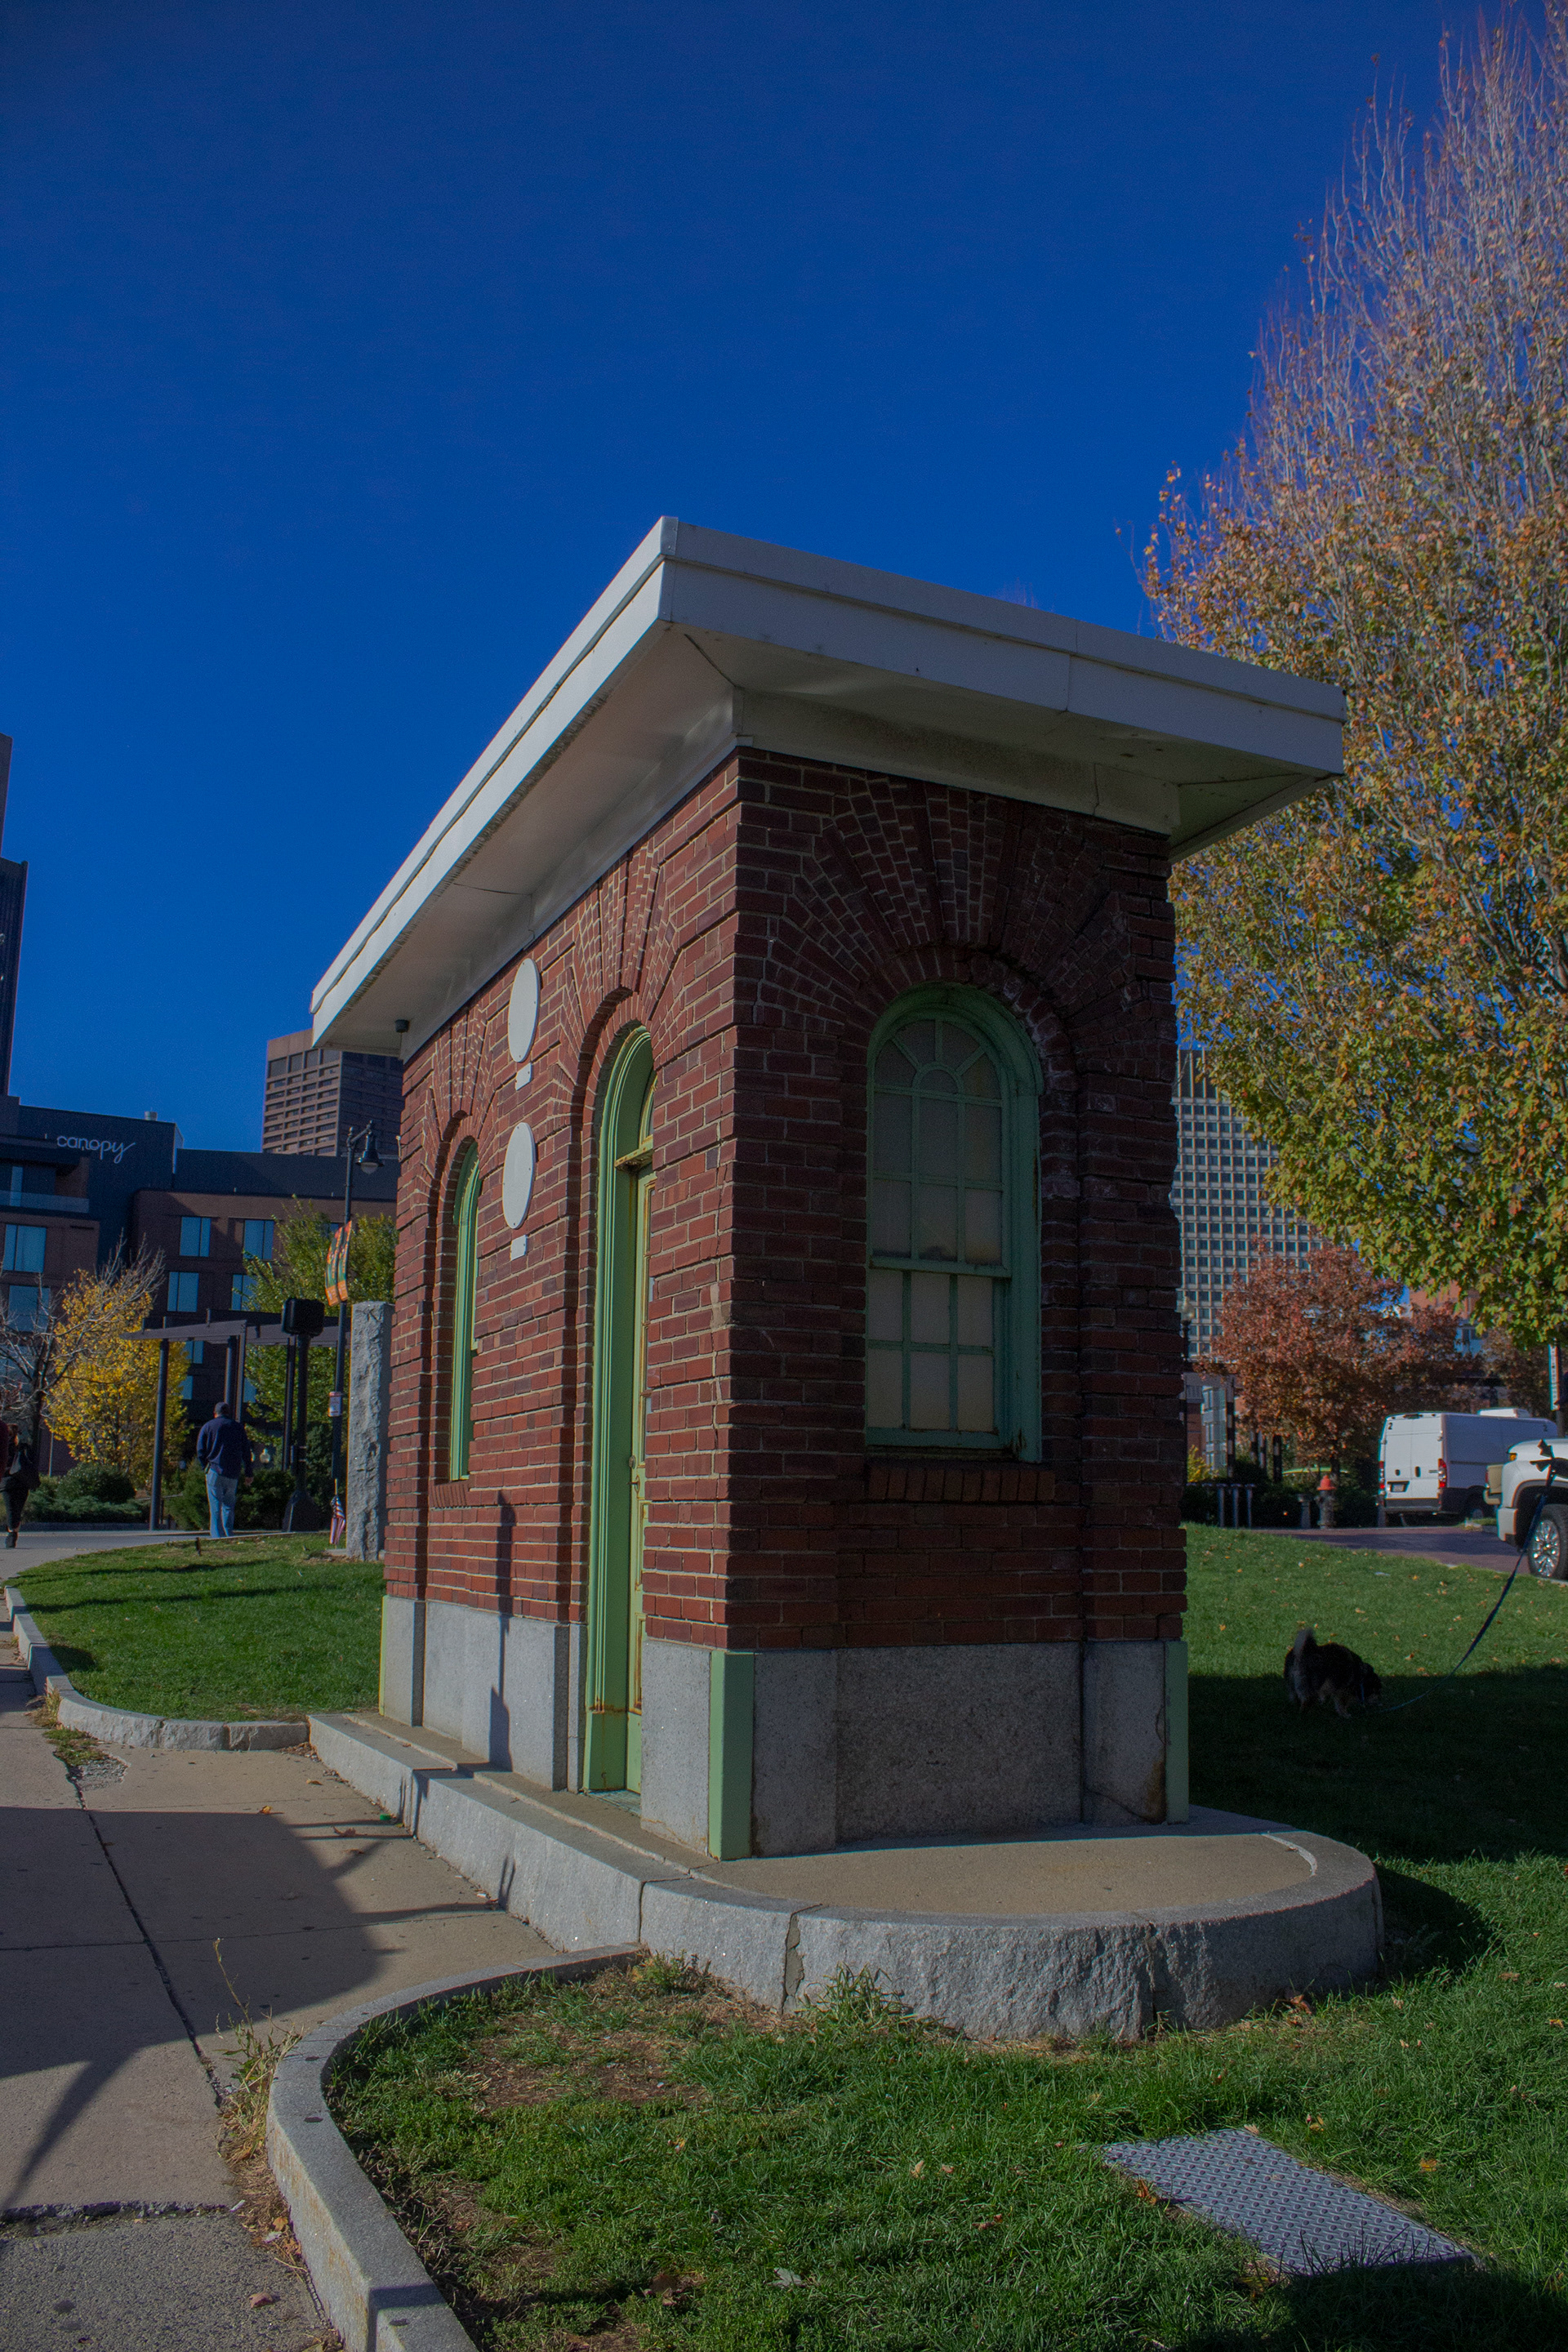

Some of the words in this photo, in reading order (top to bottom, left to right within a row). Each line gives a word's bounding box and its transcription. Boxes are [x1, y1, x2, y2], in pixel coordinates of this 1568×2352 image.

[56, 1135, 136, 1164] canopy
[1388, 1422, 1392, 1430] 2
[1543, 1423, 1548, 1432] 2
